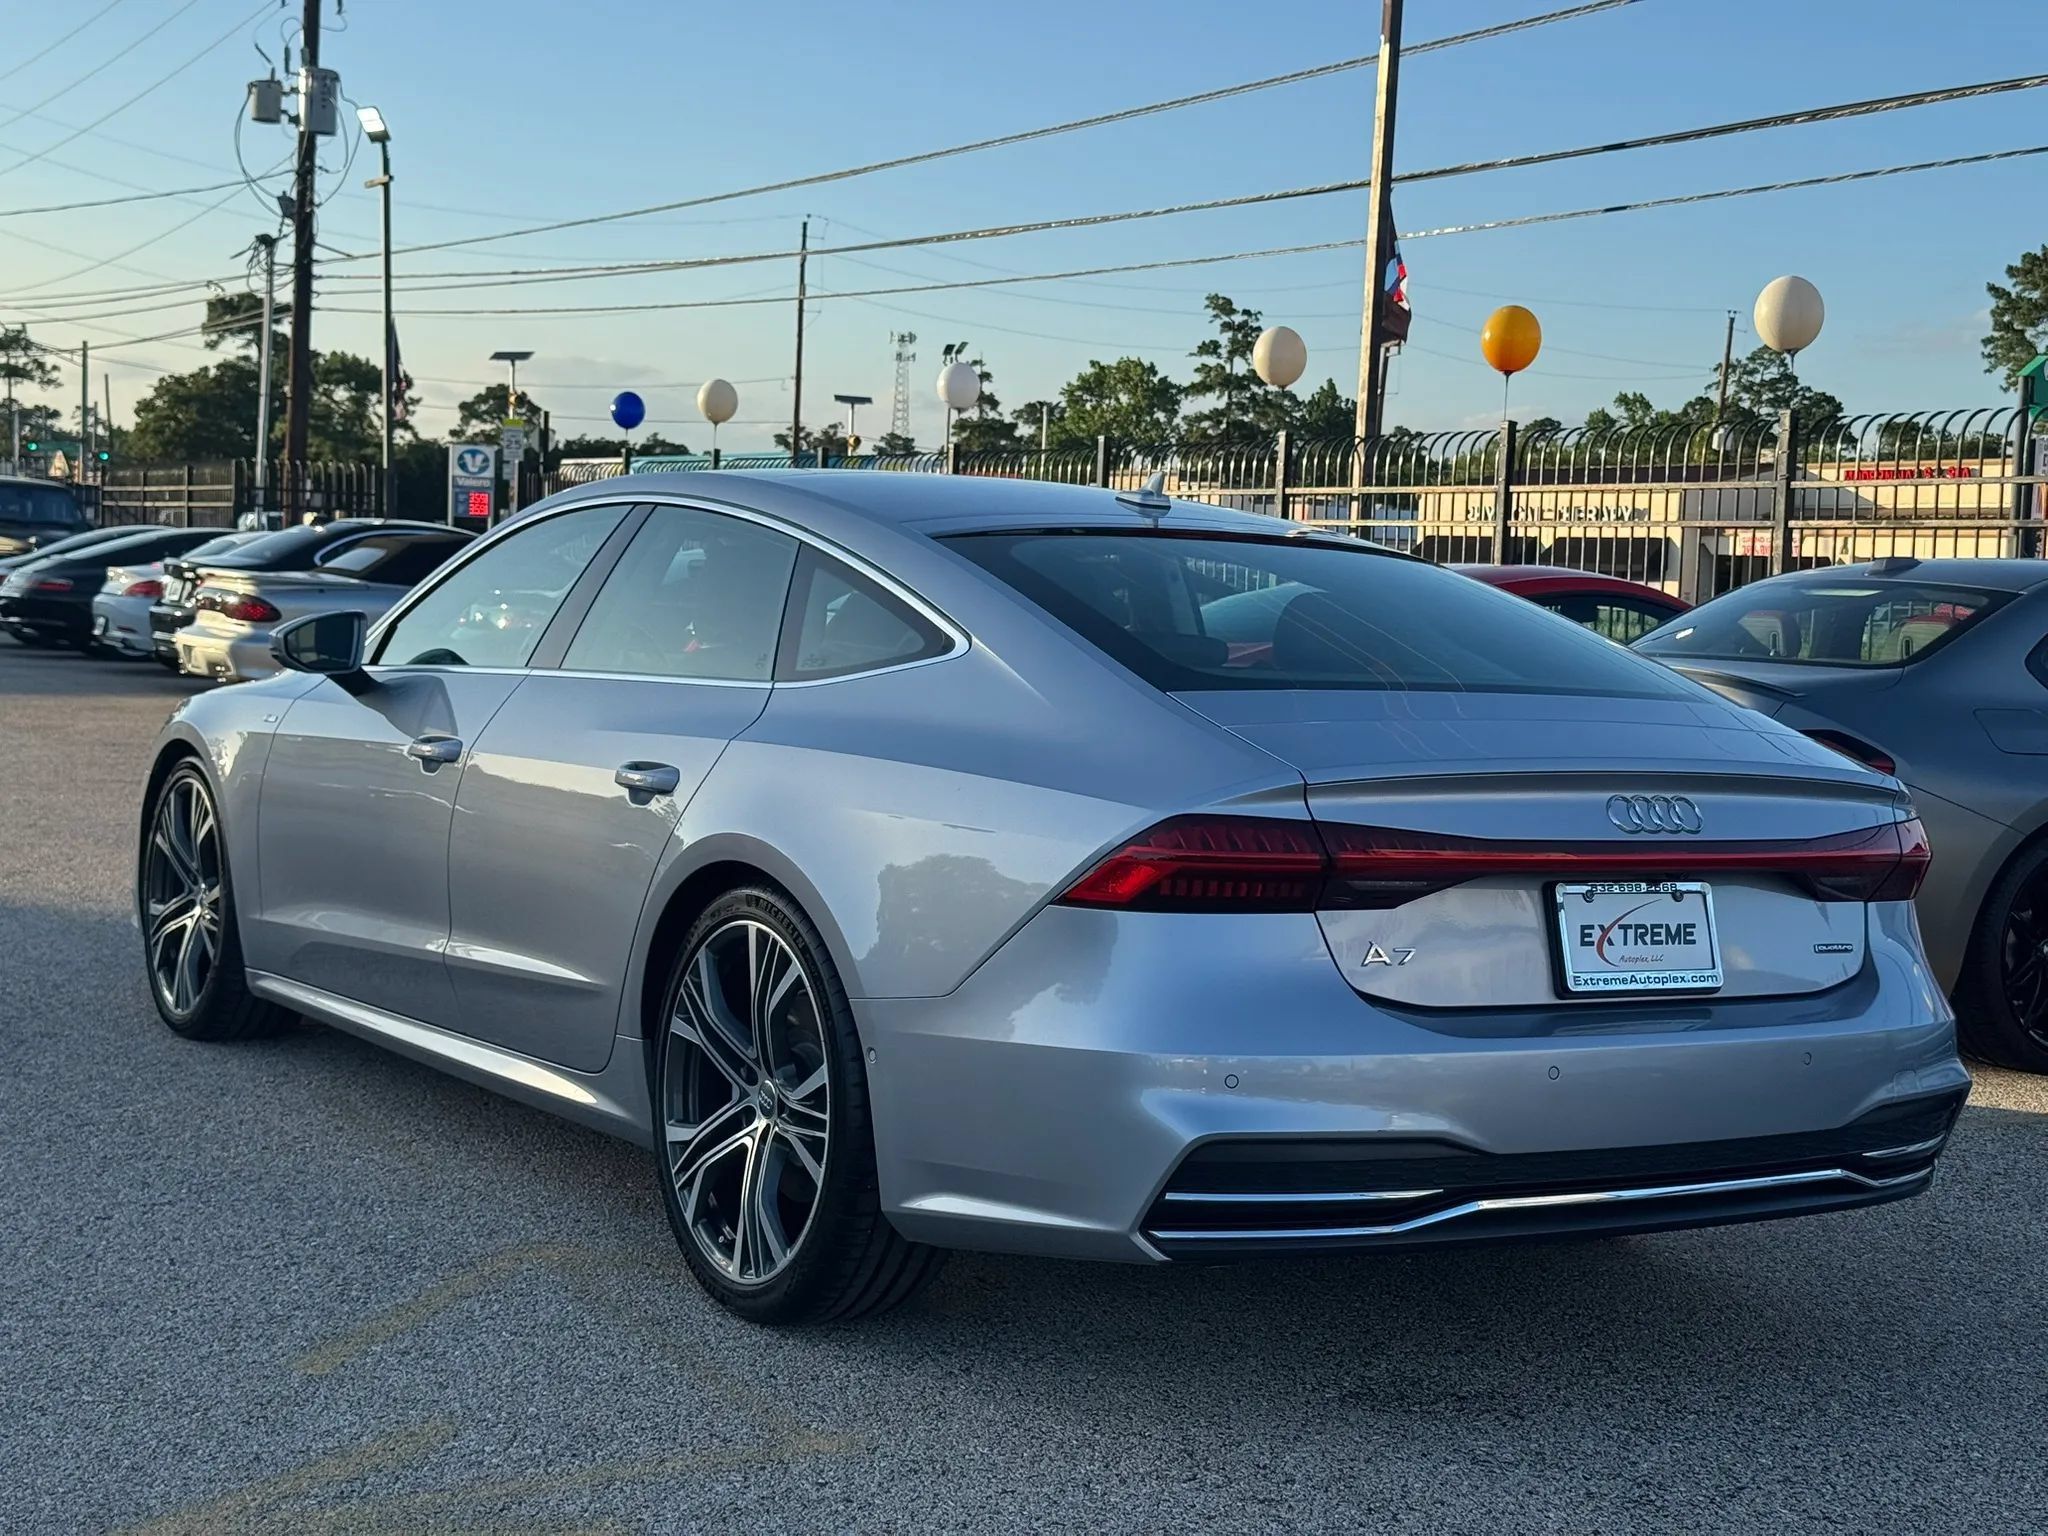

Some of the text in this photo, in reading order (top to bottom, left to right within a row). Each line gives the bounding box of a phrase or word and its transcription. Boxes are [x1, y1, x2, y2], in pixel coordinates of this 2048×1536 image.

[1580, 923, 1697, 947] EXTREME
[1361, 941, 1416, 967] A7
[1573, 973, 1718, 986] ExtremeAutoplex.com
